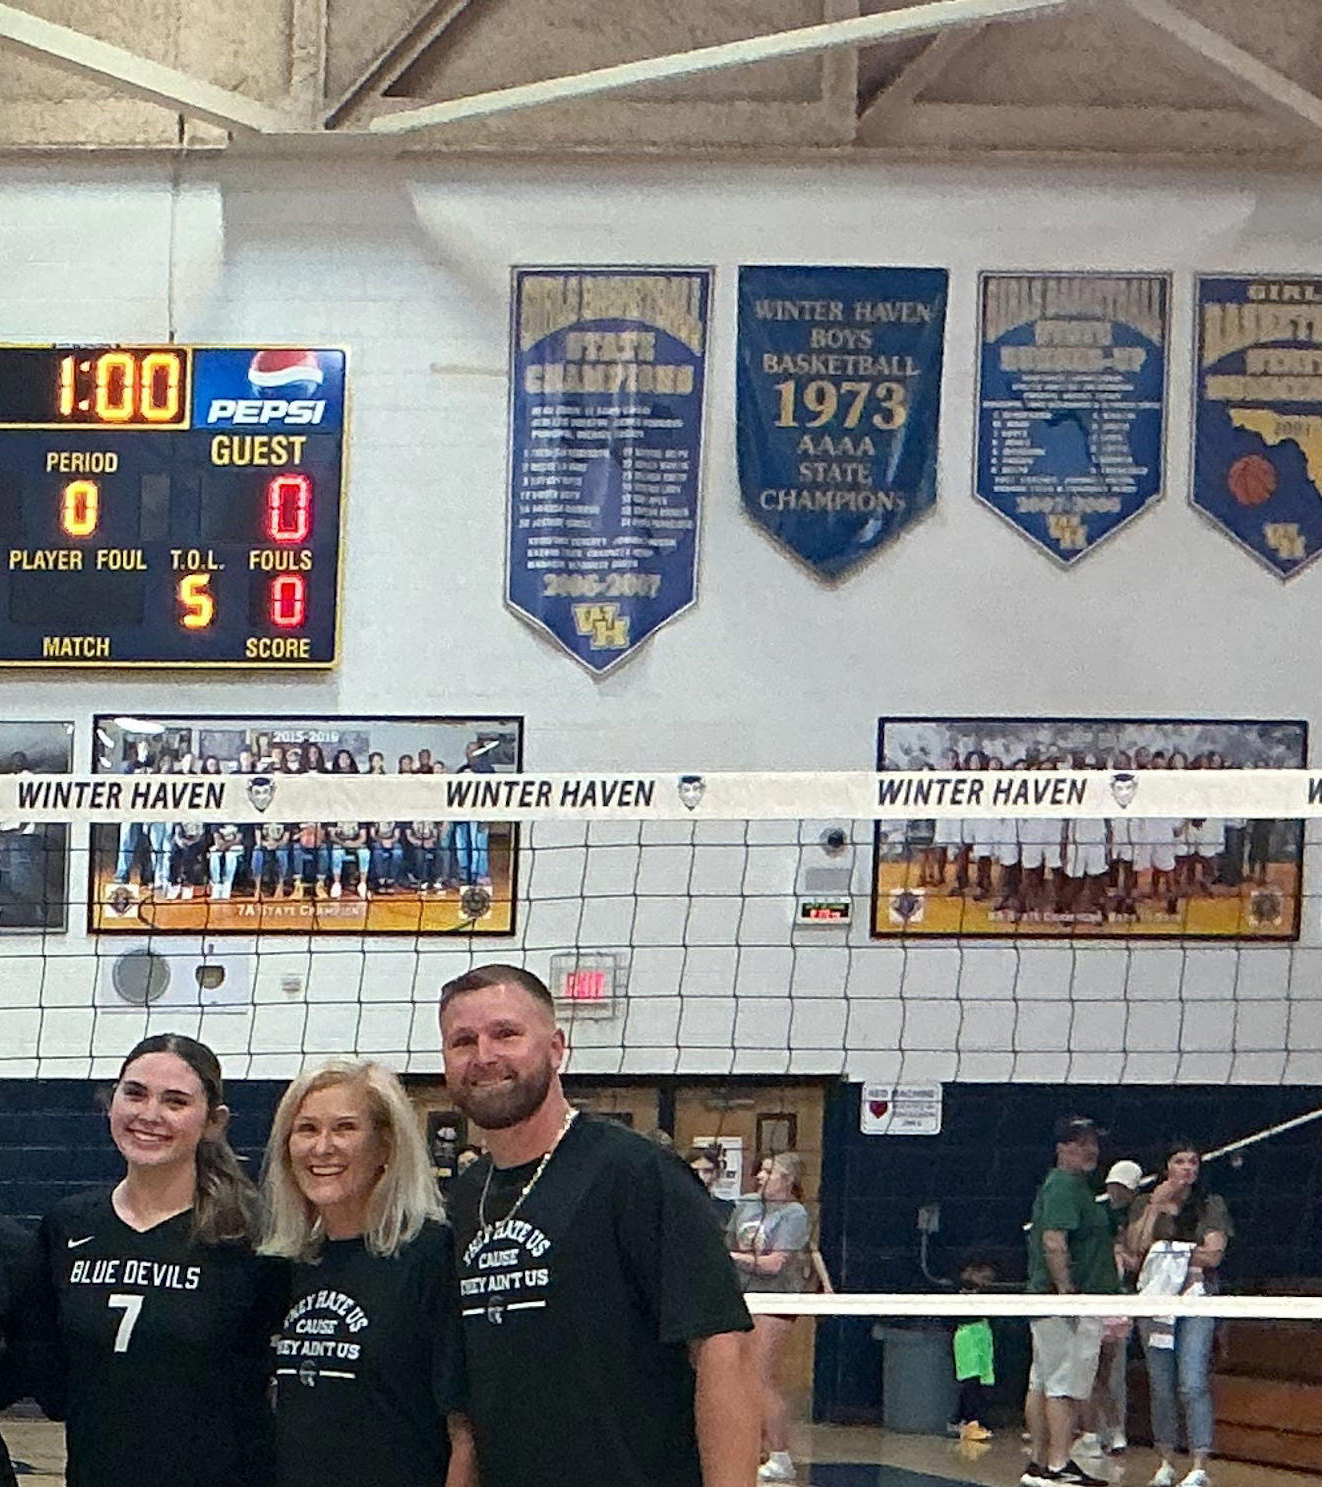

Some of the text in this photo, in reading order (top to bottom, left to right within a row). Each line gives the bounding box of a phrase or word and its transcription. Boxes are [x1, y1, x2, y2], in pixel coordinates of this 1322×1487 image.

[755, 301, 933, 324] WINTER HAVEN
[811, 328, 873, 349] BOYS
[763, 354, 919, 376] BASKETBALL
[59, 352, 179, 421] 1:00
[207, 400, 326, 424] PEPSI
[774, 381, 908, 430] 1973
[211, 436, 306, 465] GUEST
[796, 435, 876, 457] AAAA
[46, 452, 119, 474] PERIOD
[797, 463, 872, 487] STATE
[63, 480, 99, 537] 0
[269, 475, 309, 542] 0
[760, 489, 907, 512] CHAMPIONS
[9, 549, 147, 571] PLAYER FOUL
[171, 549, 225, 570] T.O.L.
[249, 550, 312, 571] FOULS
[179, 573, 214, 629] 5
[272, 574, 306, 627] 0
[43, 637, 110, 657] MATCH
[246, 638, 310, 658] SCORE
[18, 781, 225, 809] WINTER HAVEN
[446, 780, 656, 808] WINTER HAVEN
[877, 778, 1088, 806] WINTER HAVEN
[525, 1226, 551, 1257] US
[478, 1249, 520, 1270] CAUSE
[70, 1260, 200, 1290] BLUE DEVILS
[524, 1269, 549, 1288] US
[107, 1294, 145, 1353] 7
[315, 1290, 354, 1316] HATE
[344, 1307, 369, 1333] US
[295, 1319, 338, 1335] CAUSE
[337, 1342, 361, 1360] US
